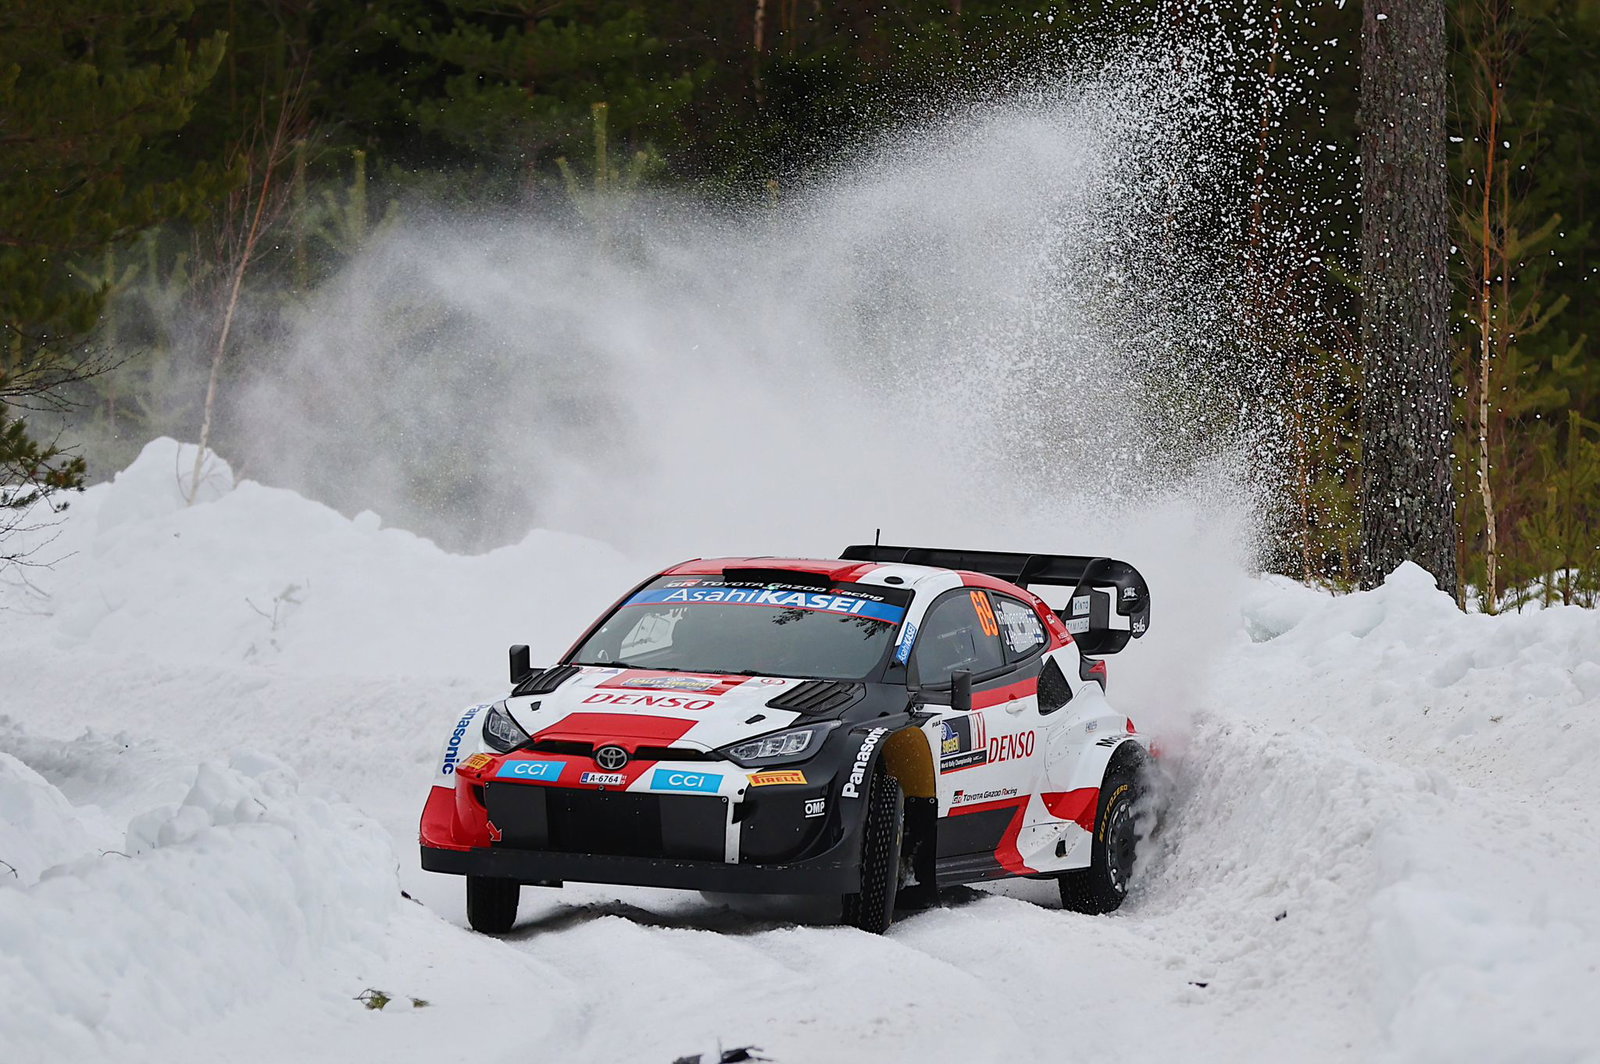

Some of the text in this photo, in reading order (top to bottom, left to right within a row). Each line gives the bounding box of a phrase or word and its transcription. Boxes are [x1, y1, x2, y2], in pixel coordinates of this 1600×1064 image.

[701, 580, 764, 588] TOYOTA
[766, 582, 827, 593] GAZOO
[829, 588, 884, 602] Racing
[970, 590, 999, 637] 69
[582, 693, 715, 711] DENSO
[442, 704, 492, 775] Panasonic
[987, 730, 1035, 764] DENSO
[588, 774, 619, 784] A-6764
[753, 770, 802, 784] PIRELLI
[963, 793, 983, 802] TOYOTA
[1002, 788, 1018, 796] Racing
[805, 801, 826, 816] OMP
